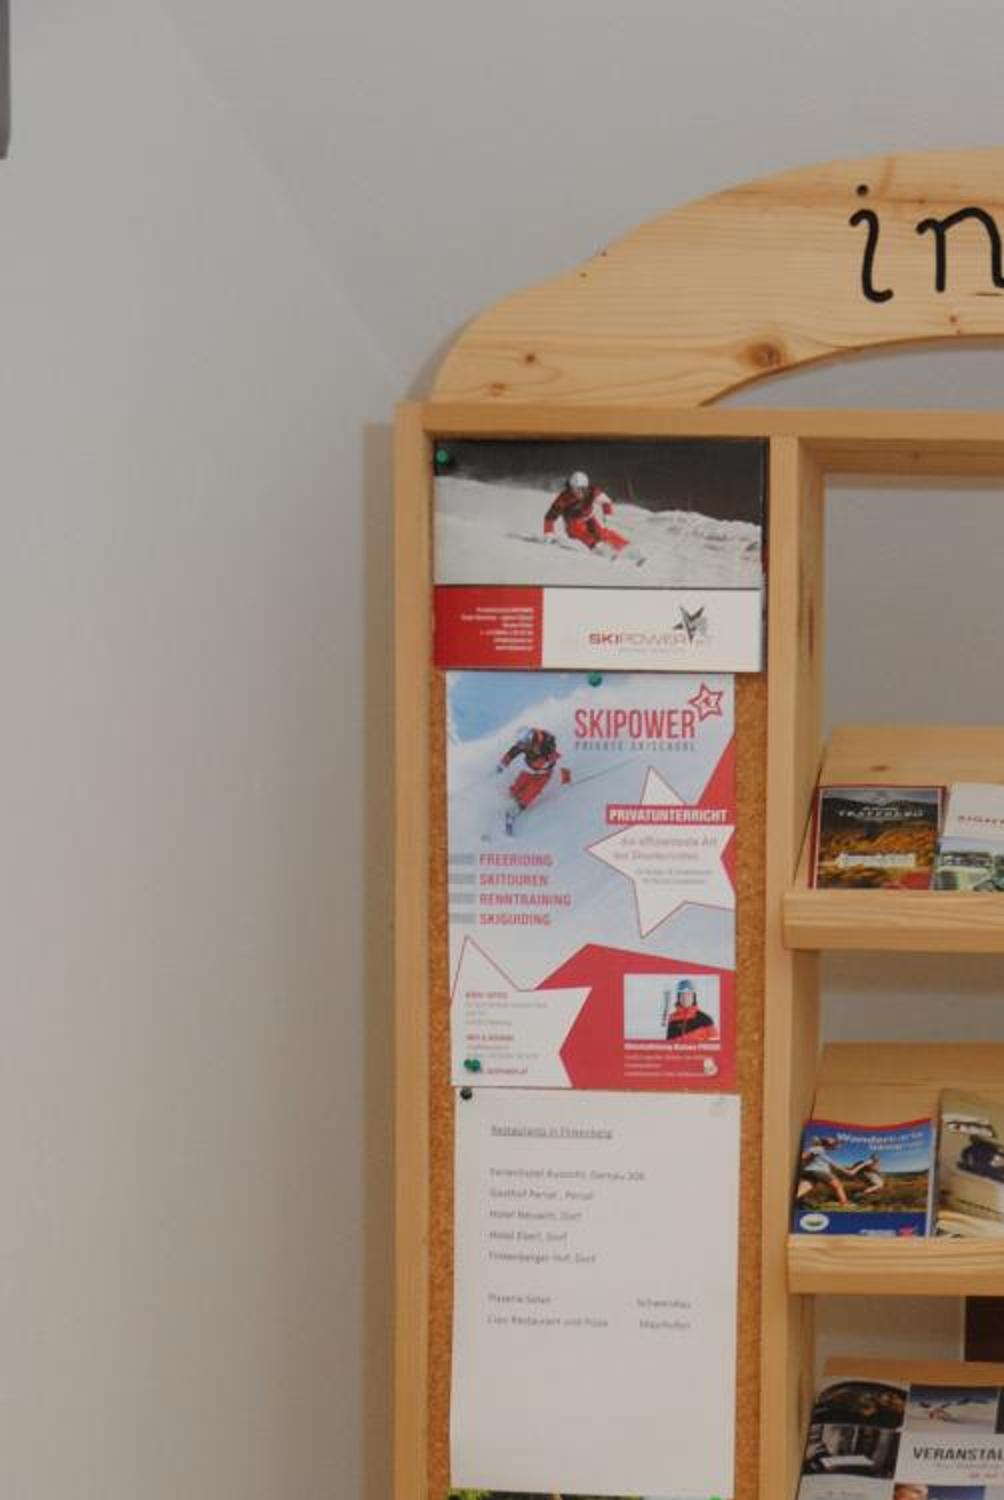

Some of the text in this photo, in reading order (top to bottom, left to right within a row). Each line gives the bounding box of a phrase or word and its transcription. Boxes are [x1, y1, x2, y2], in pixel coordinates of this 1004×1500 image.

[575, 708, 696, 739] SKIPOWER
[608, 808, 728, 822] PRIVATUNTERRICHT
[479, 853, 553, 866] FREERIDING
[479, 873, 548, 886] SKITOUREN
[479, 893, 572, 907] RENNTRAINING
[479, 913, 552, 926] SKIGUIDING
